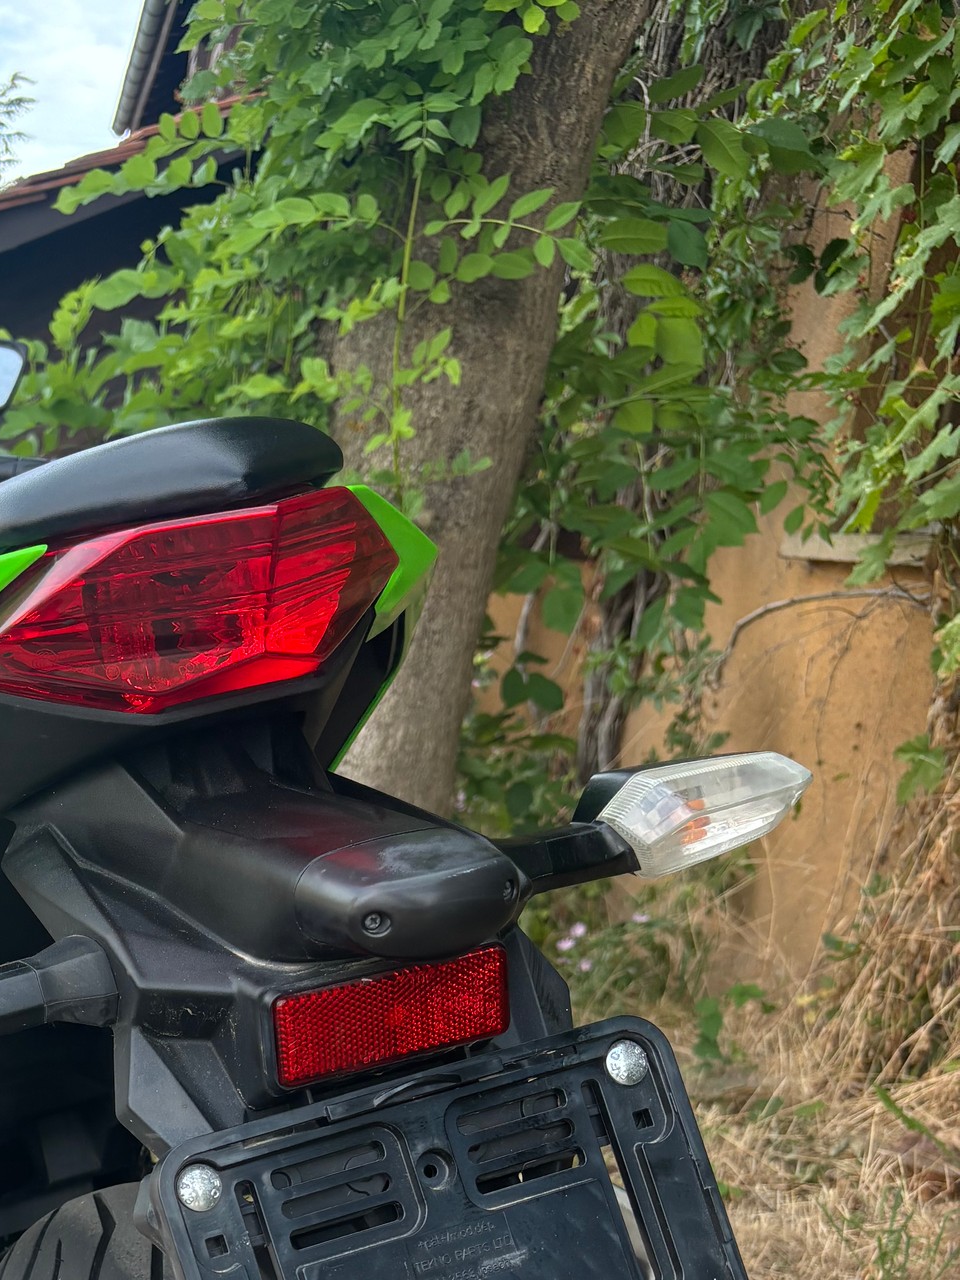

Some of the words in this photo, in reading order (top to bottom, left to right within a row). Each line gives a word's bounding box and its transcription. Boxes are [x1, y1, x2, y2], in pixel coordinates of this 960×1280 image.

[414, 1253, 452, 1273] TEKNO
[455, 1241, 491, 1261] PARTS
[493, 1234, 514, 1250] LTD
